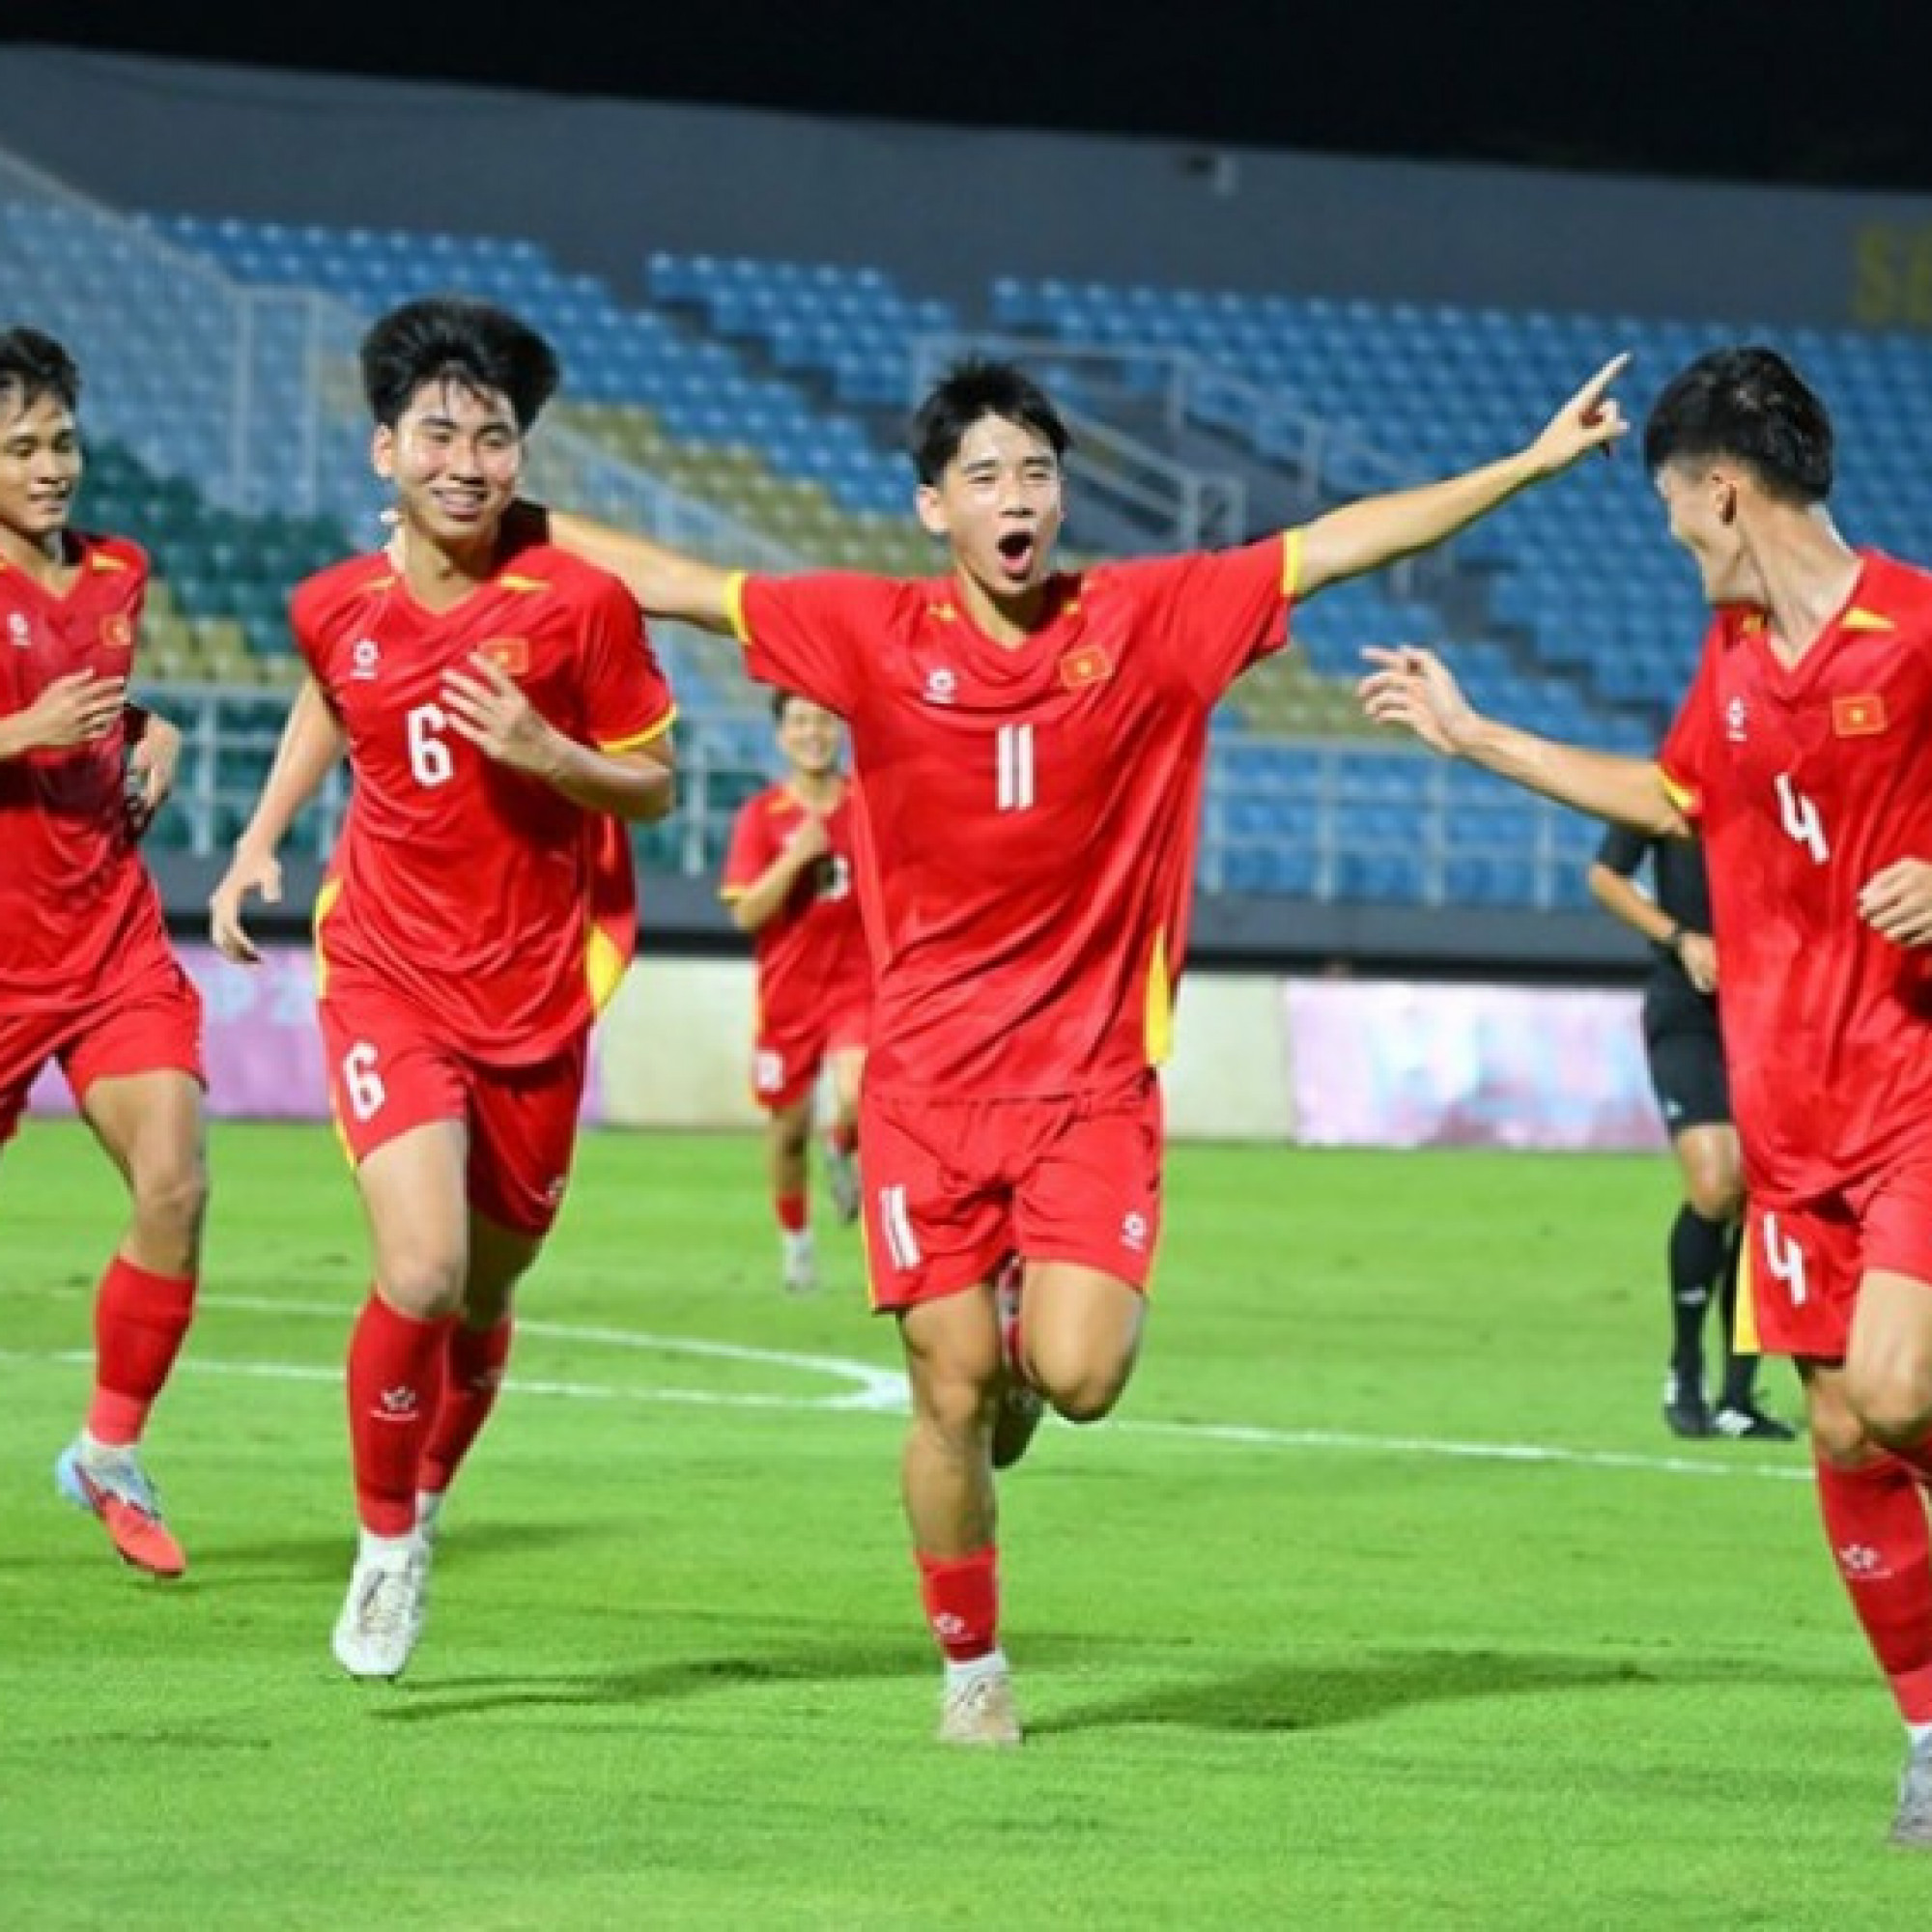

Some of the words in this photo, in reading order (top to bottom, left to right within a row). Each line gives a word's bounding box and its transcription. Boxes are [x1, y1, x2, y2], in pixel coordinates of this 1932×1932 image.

[406, 704, 454, 787] 6
[996, 723, 1036, 810] 11
[1775, 772, 1830, 865] 4
[343, 1039, 386, 1122] 6
[879, 1185, 922, 1271] 11
[1763, 1210, 1806, 1306] 4
